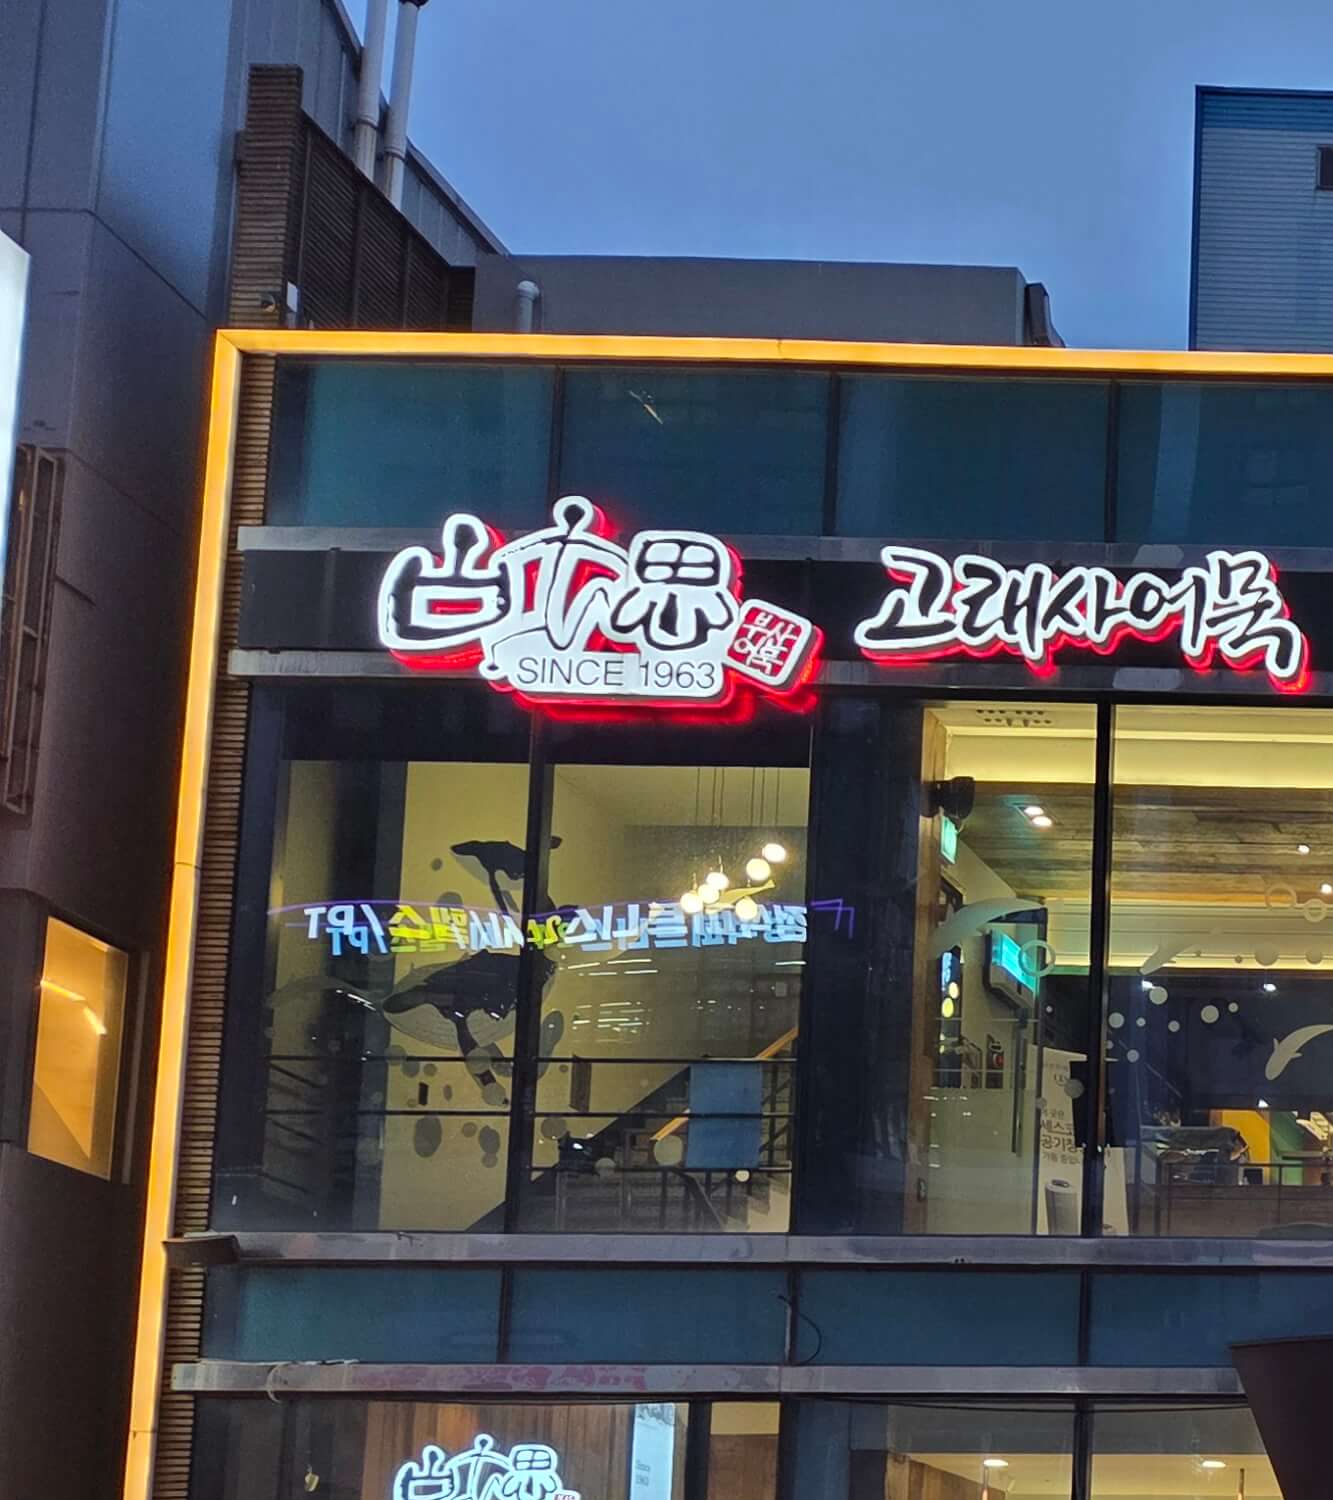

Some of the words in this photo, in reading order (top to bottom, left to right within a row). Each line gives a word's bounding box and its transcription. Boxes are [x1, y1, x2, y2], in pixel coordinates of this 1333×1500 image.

[855, 546, 1301, 678] 고래사어묵
[516, 658, 624, 687] SINCE
[639, 660, 716, 689] 1963
